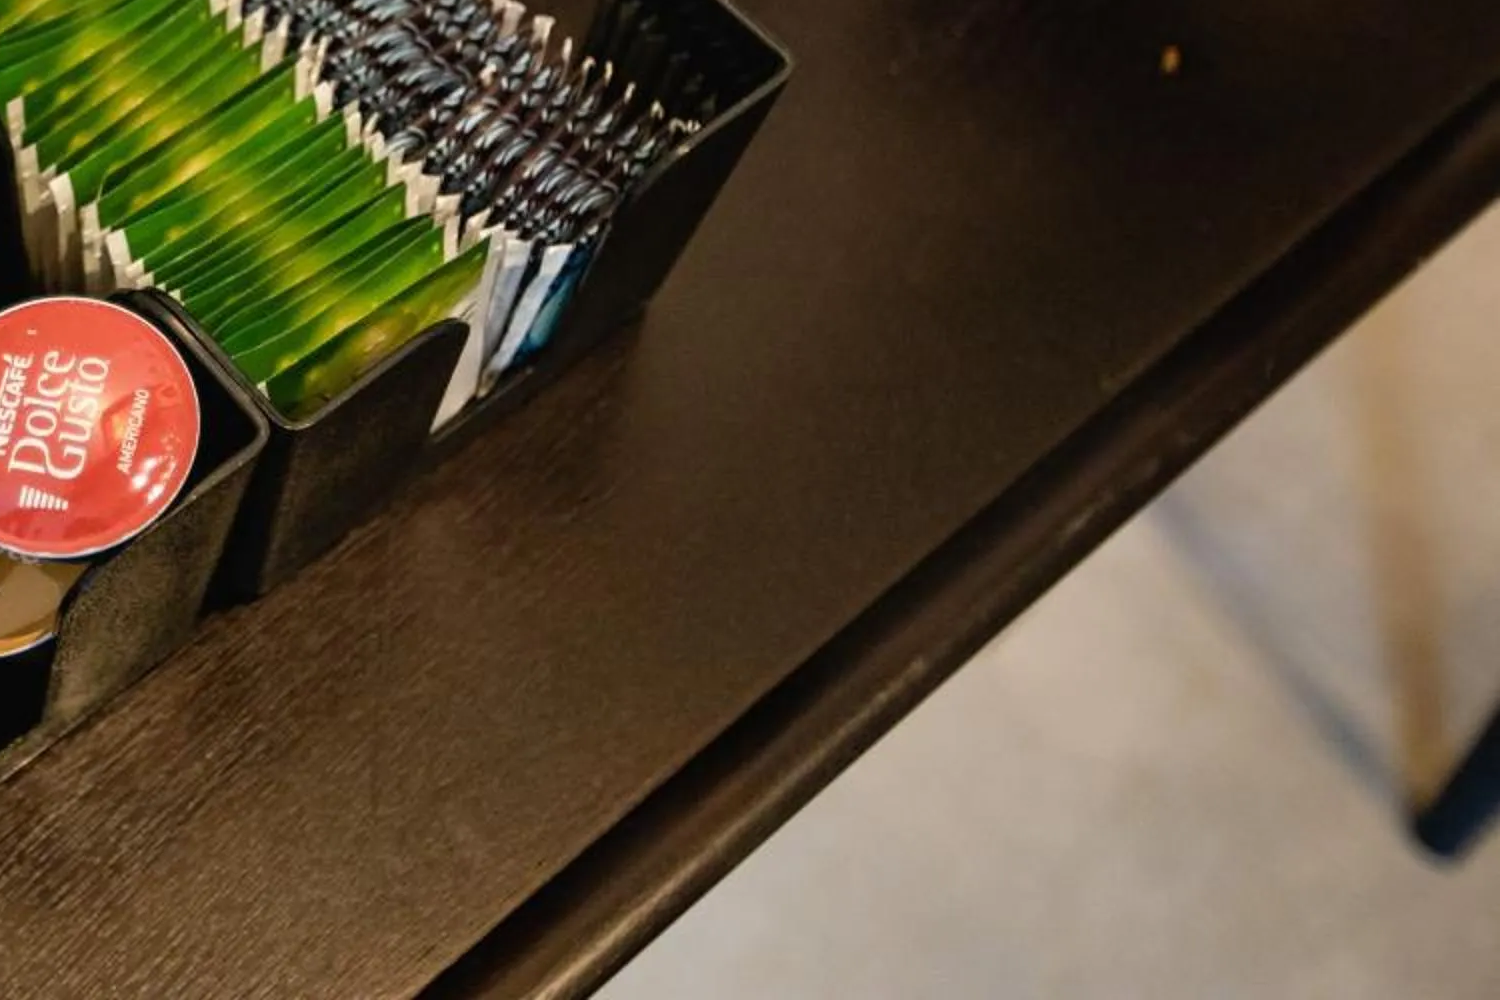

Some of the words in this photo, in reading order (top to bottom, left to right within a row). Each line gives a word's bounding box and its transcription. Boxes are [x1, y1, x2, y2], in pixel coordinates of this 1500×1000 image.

[7, 350, 76, 475] Dolce
[46, 356, 112, 481] Gusto
[116, 388, 151, 475] AMERICANO
